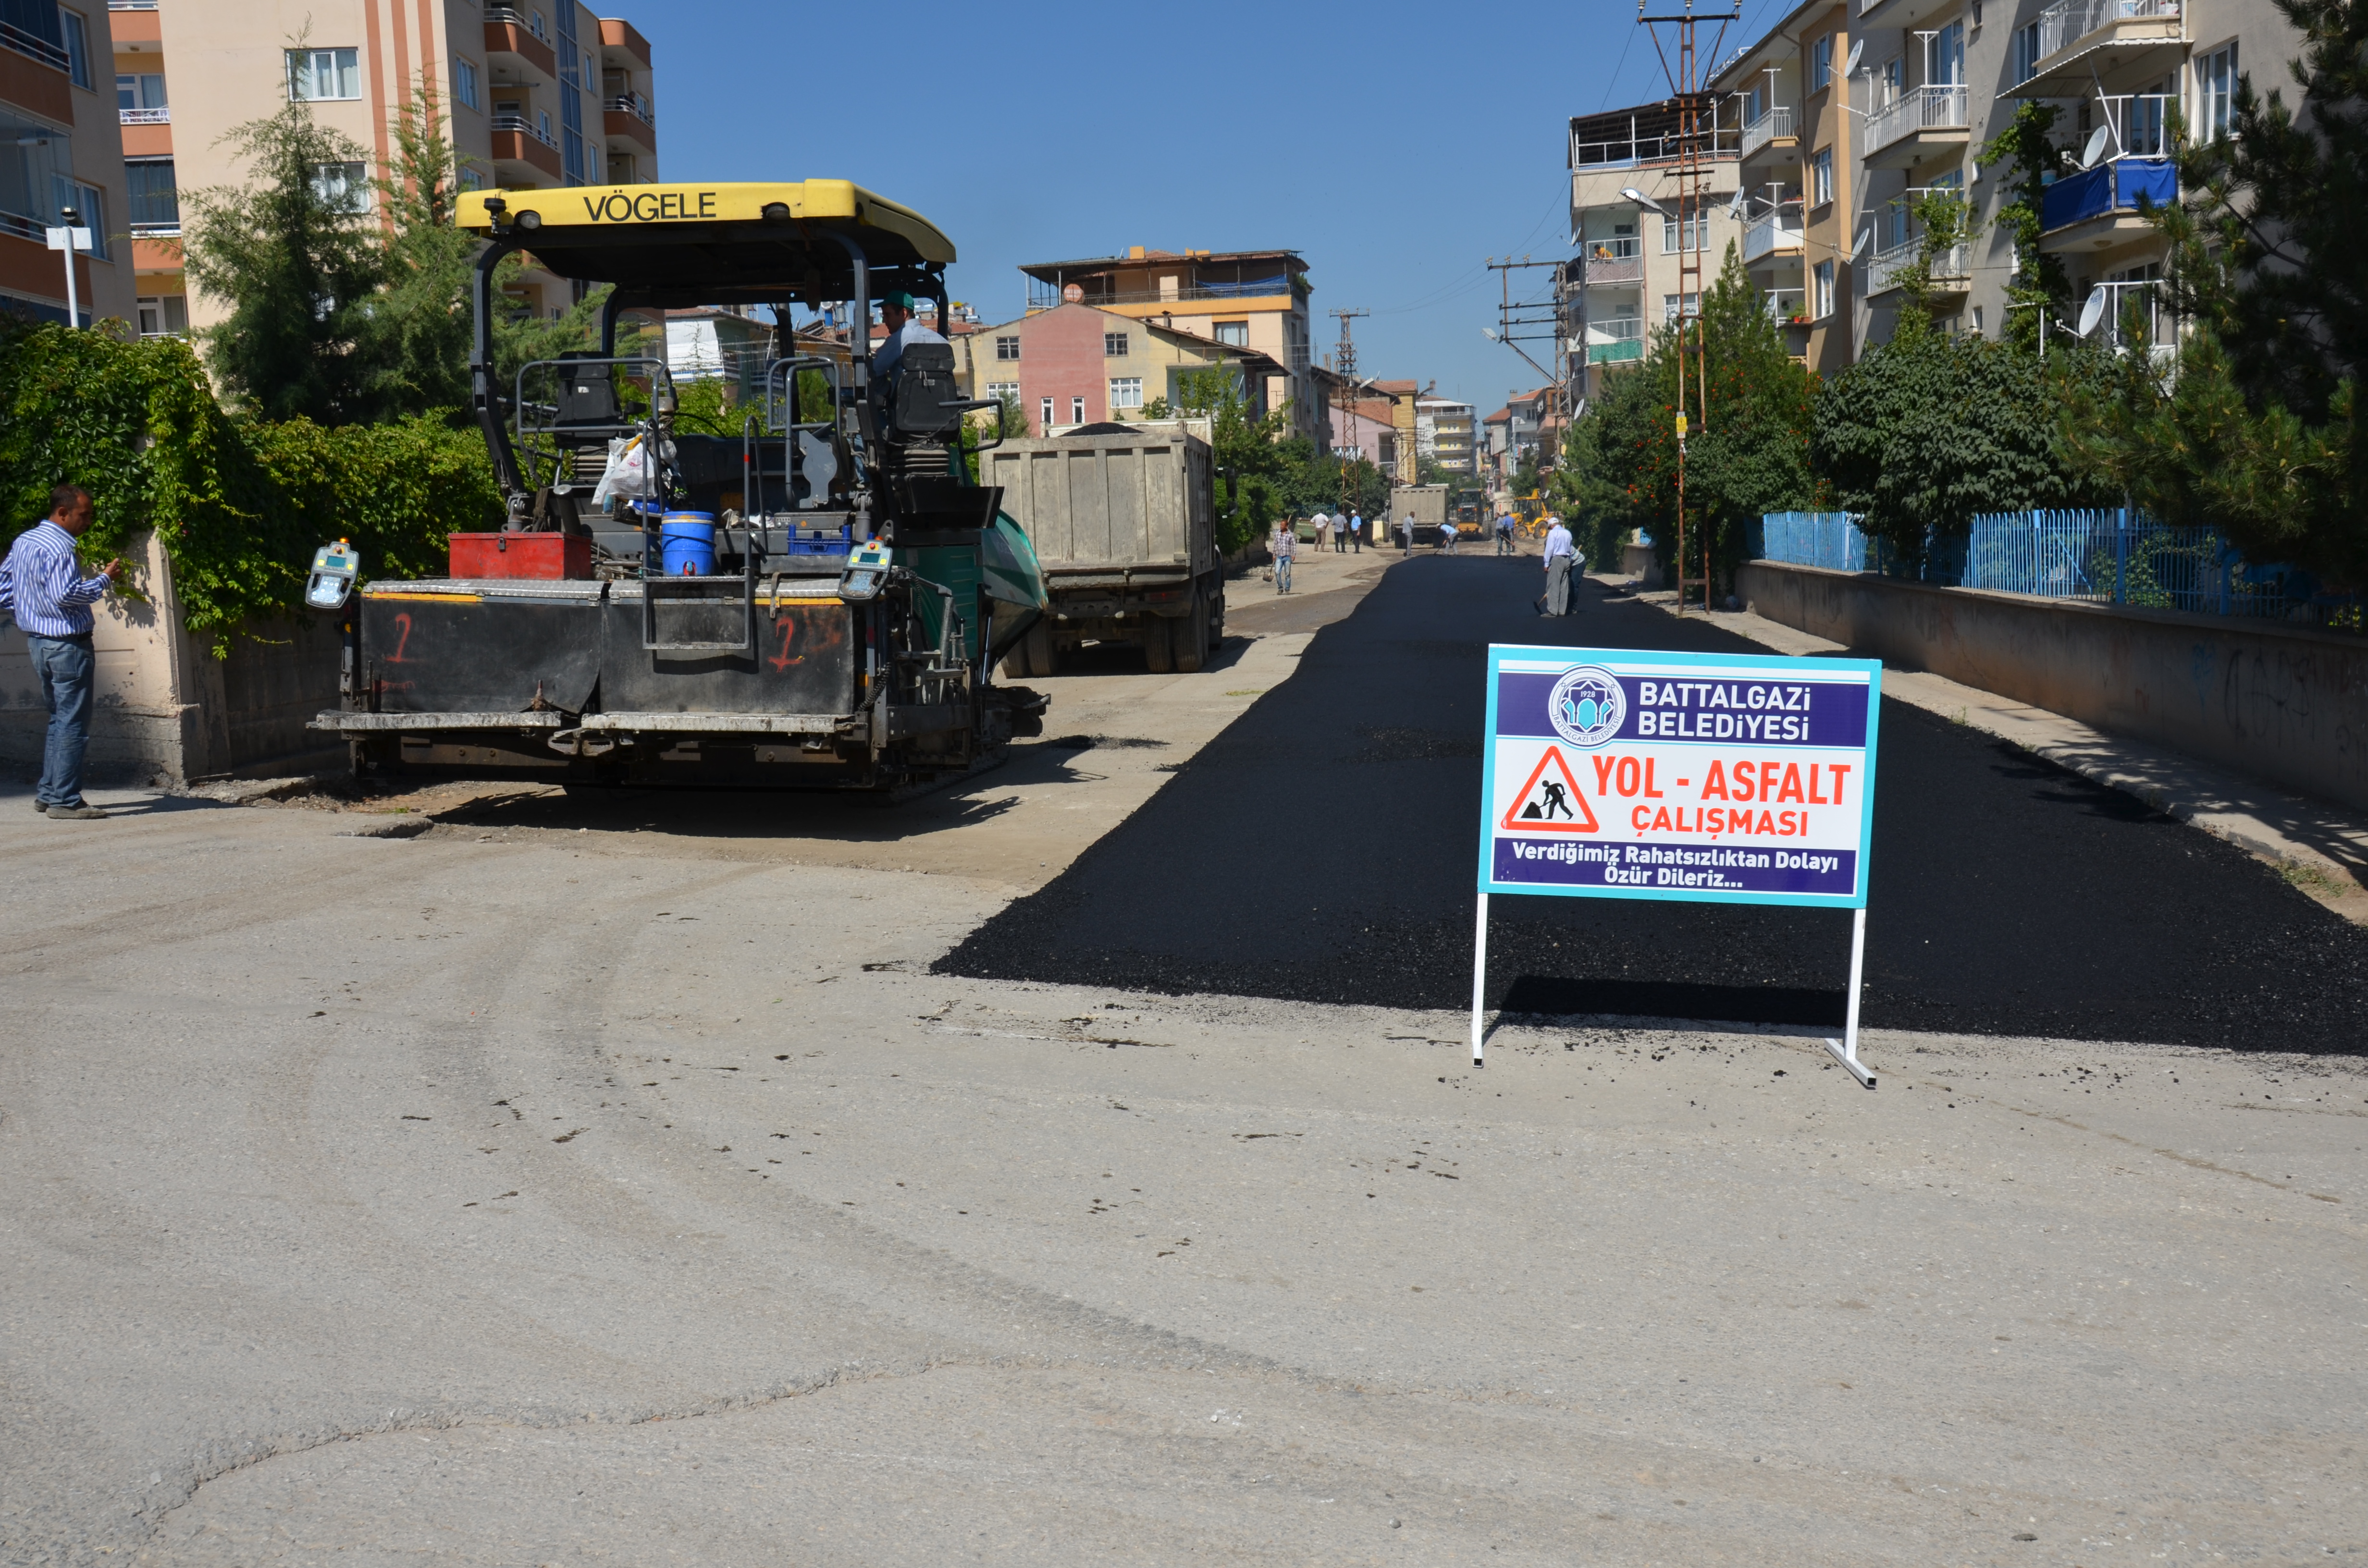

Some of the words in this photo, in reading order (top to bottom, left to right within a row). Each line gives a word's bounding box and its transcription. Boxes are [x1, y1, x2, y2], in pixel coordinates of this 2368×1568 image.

[583, 190, 716, 221] VÖGELE
[1592, 755, 1663, 798] YOL
[1700, 760, 1851, 805] ASFALT
[1631, 805, 1808, 840] ÇALIŞMASI
[1513, 842, 1620, 865] Verdiğimiz
[1626, 846, 1770, 868] Rahatsızlıktan
[1775, 851, 1838, 873] Dolayı
[1604, 861, 1653, 884] Özür
[1658, 868, 1743, 887] Dileriz...
